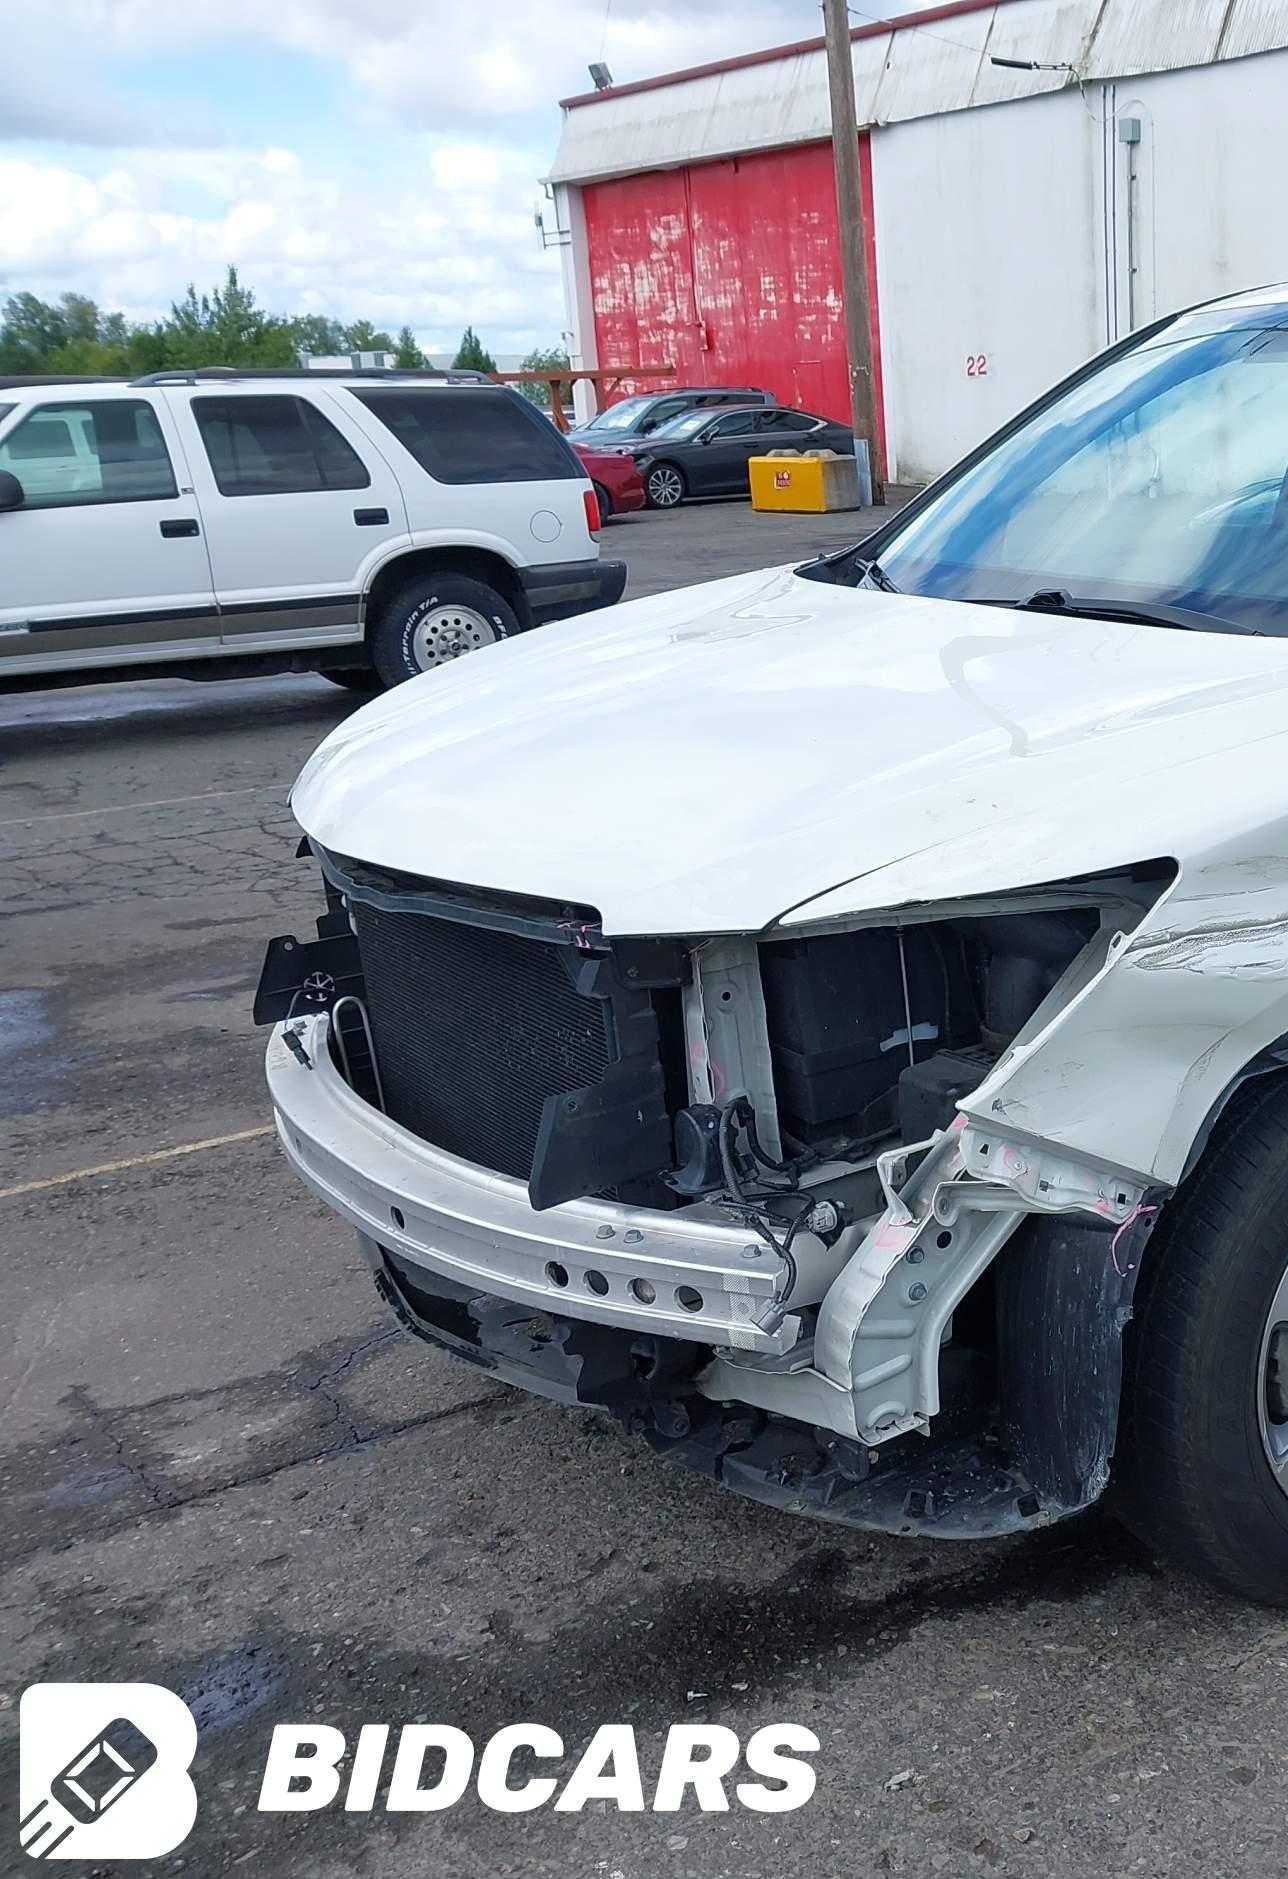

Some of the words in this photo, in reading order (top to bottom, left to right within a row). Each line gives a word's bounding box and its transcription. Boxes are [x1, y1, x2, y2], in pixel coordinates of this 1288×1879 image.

[967, 355, 987, 376] 22
[402, 611, 419, 675] ll-Terrain
[418, 596, 439, 611] T/A
